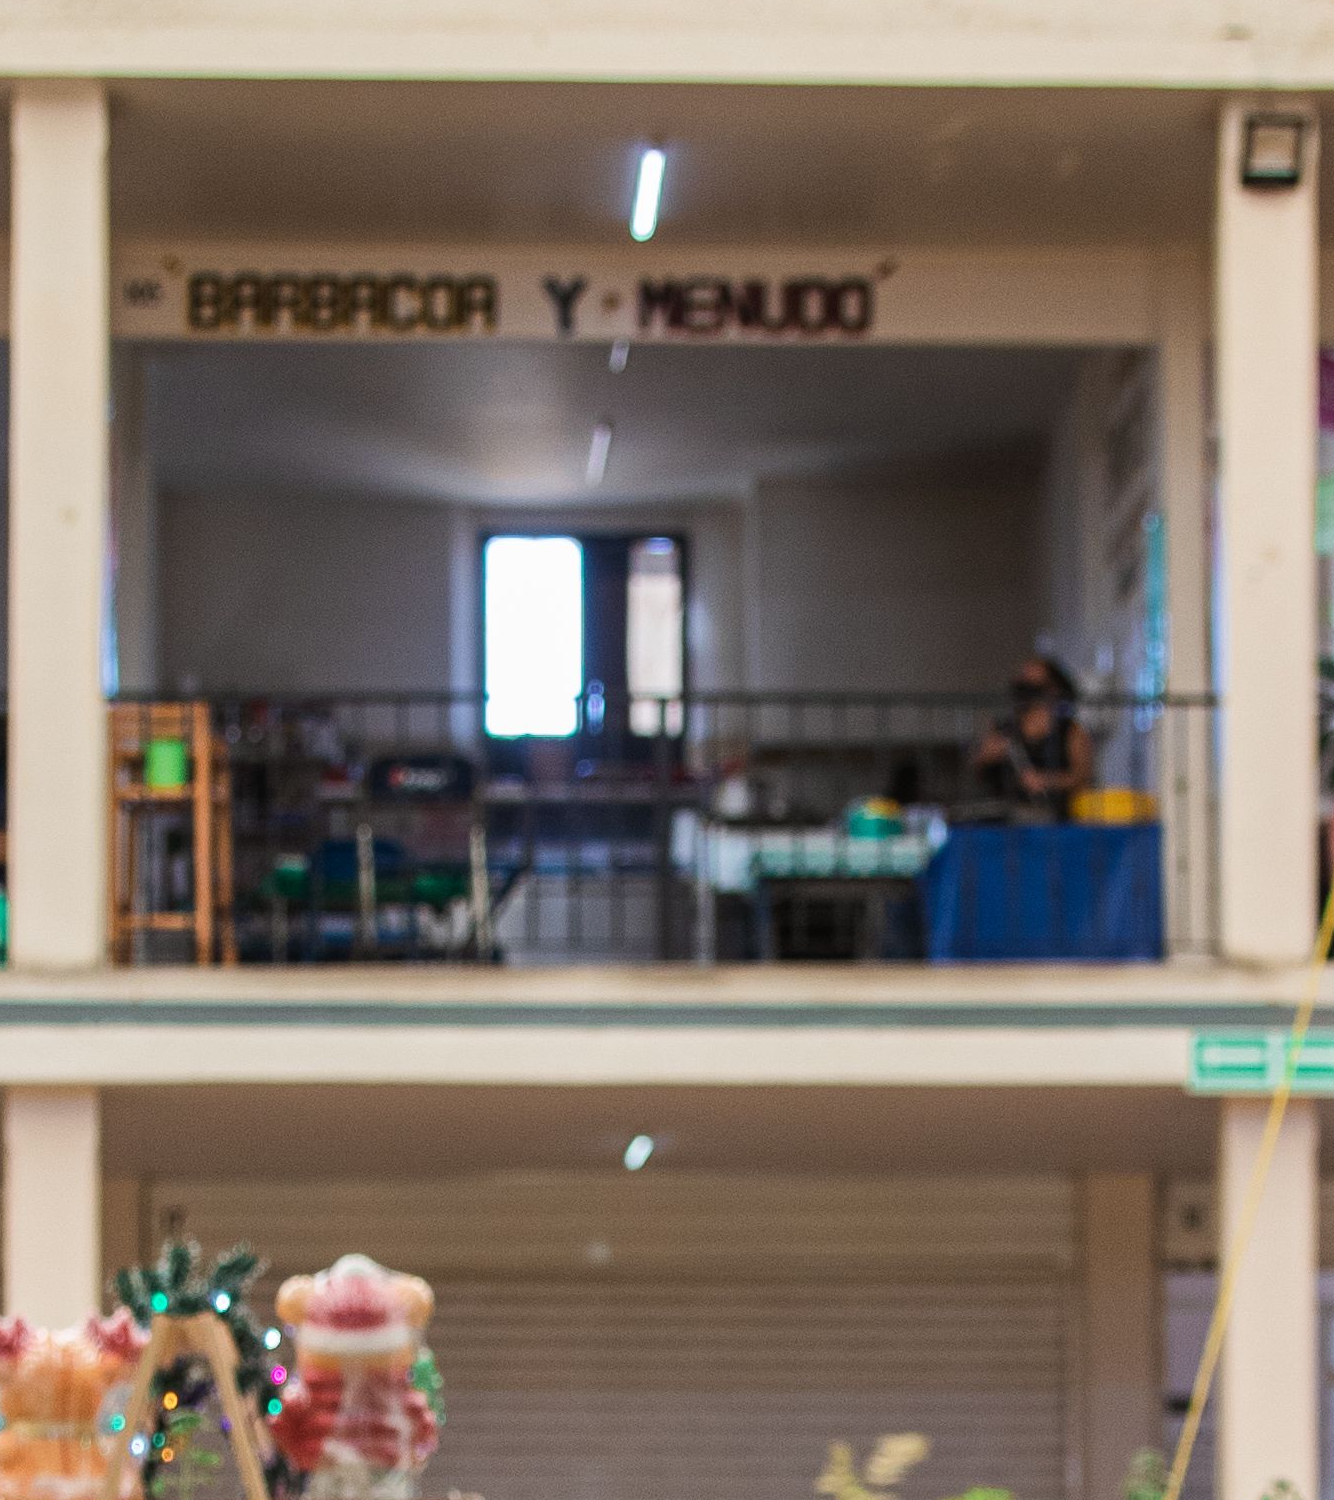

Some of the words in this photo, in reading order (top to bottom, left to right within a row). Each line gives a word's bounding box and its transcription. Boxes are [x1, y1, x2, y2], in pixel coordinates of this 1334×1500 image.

[188, 270, 499, 330] BARBACOA
[541, 274, 586, 337] Y
[637, 274, 874, 332] MENUDO
